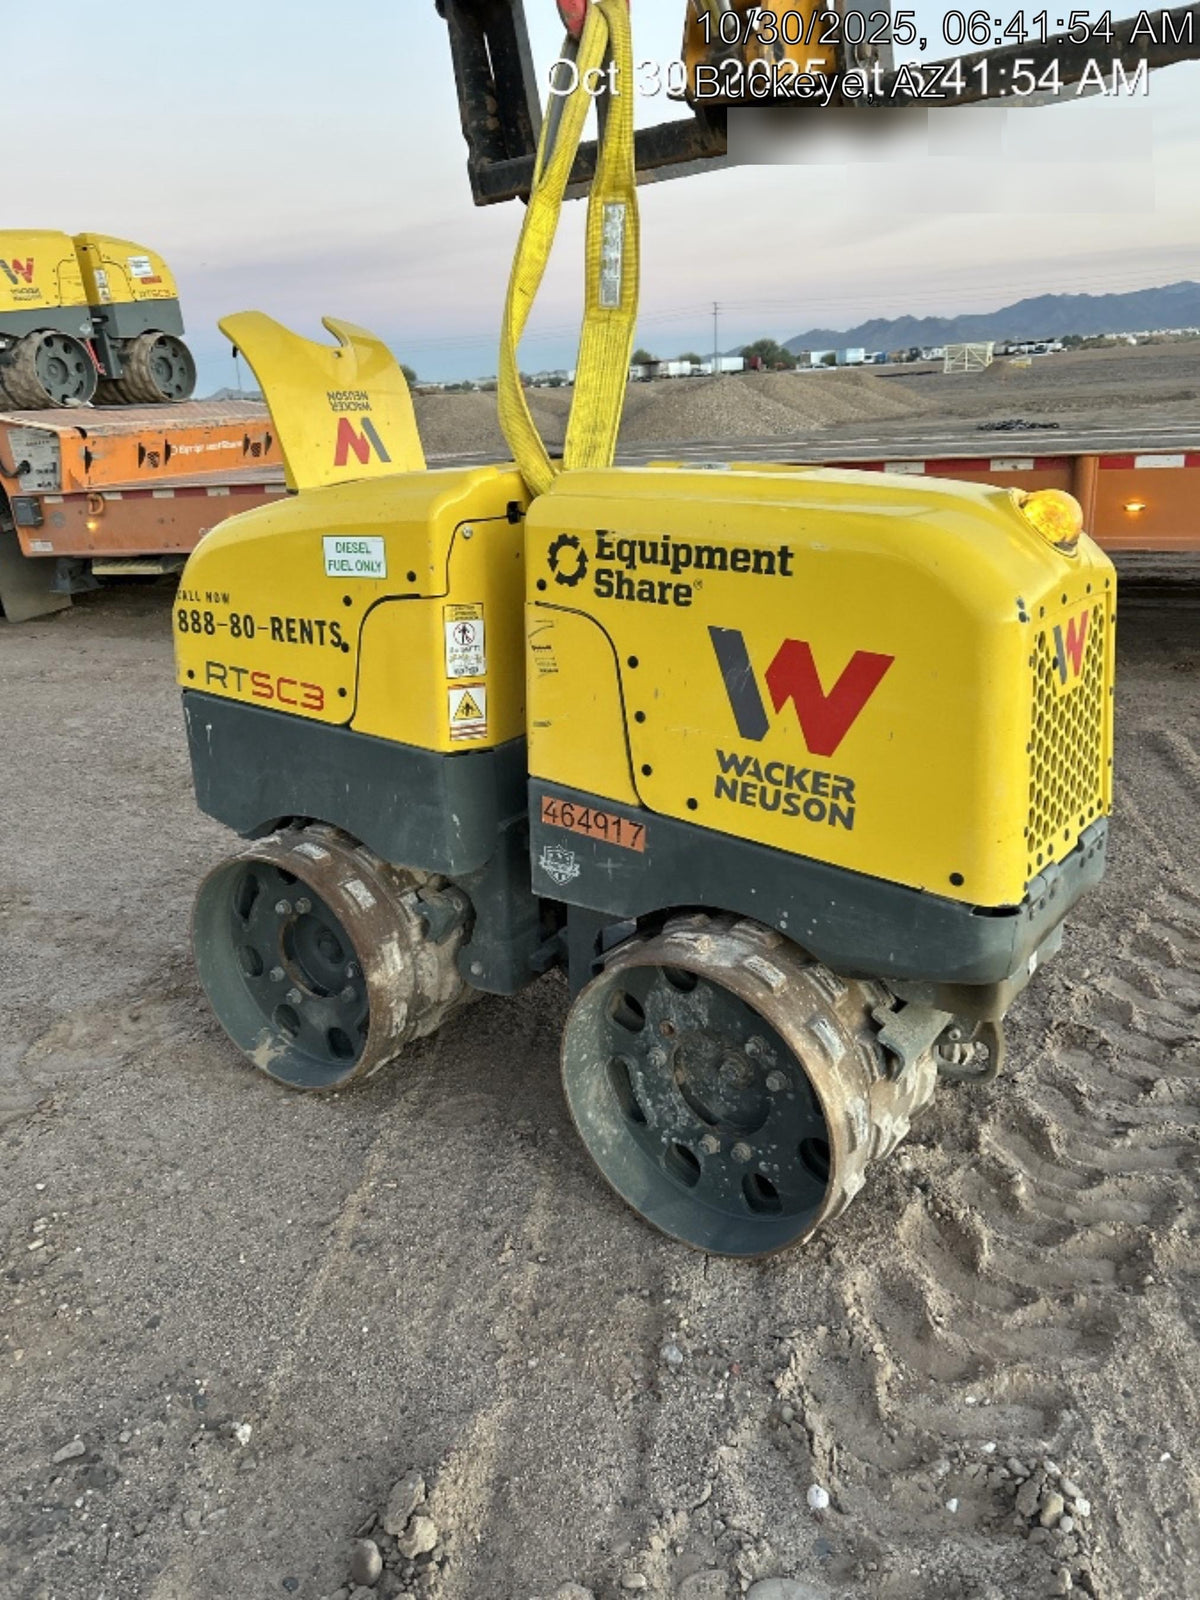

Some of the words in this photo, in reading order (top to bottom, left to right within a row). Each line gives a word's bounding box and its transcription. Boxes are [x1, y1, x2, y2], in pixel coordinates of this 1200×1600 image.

[328, 559, 353, 572] FUEL
[355, 559, 382, 573] ONLY
[335, 541, 372, 554] DIESEL
[595, 529, 794, 577] Equipment
[206, 660, 324, 712] RTSC3
[716, 749, 856, 804] WACKER
[543, 800, 644, 847] 464917
[714, 775, 856, 831] NEUSON
